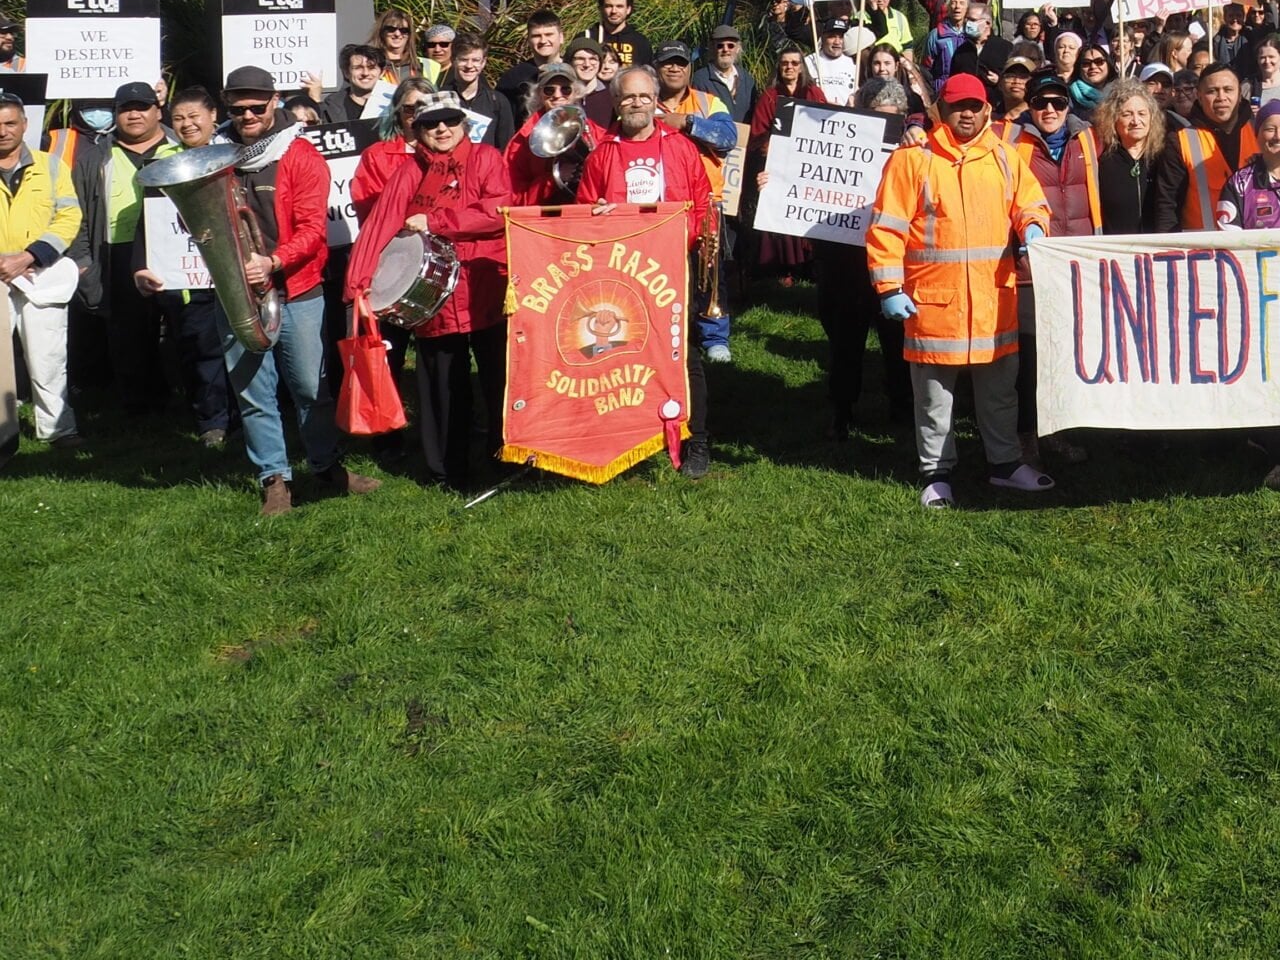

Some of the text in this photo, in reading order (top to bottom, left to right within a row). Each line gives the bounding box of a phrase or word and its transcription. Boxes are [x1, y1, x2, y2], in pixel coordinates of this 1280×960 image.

[254, 17, 307, 31] DON'T
[80, 30, 109, 42] WE
[253, 35, 309, 49] BRUSH
[55, 48, 134, 61] DESERVE
[271, 52, 293, 65] US
[60, 66, 129, 79] BETTER
[269, 70, 310, 84] SIDE
[819, 118, 857, 138] IT'S
[795, 137, 874, 163] TIME TO
[799, 162, 863, 186] PAINT
[786, 184, 867, 210] A FAIRER
[785, 204, 862, 230] PICTURE
[521, 242, 677, 314] BRASS RAZOO
[1070, 248, 1251, 385] UNITED
[546, 364, 656, 398] SOLIDARITY
[594, 387, 644, 416] BAND
